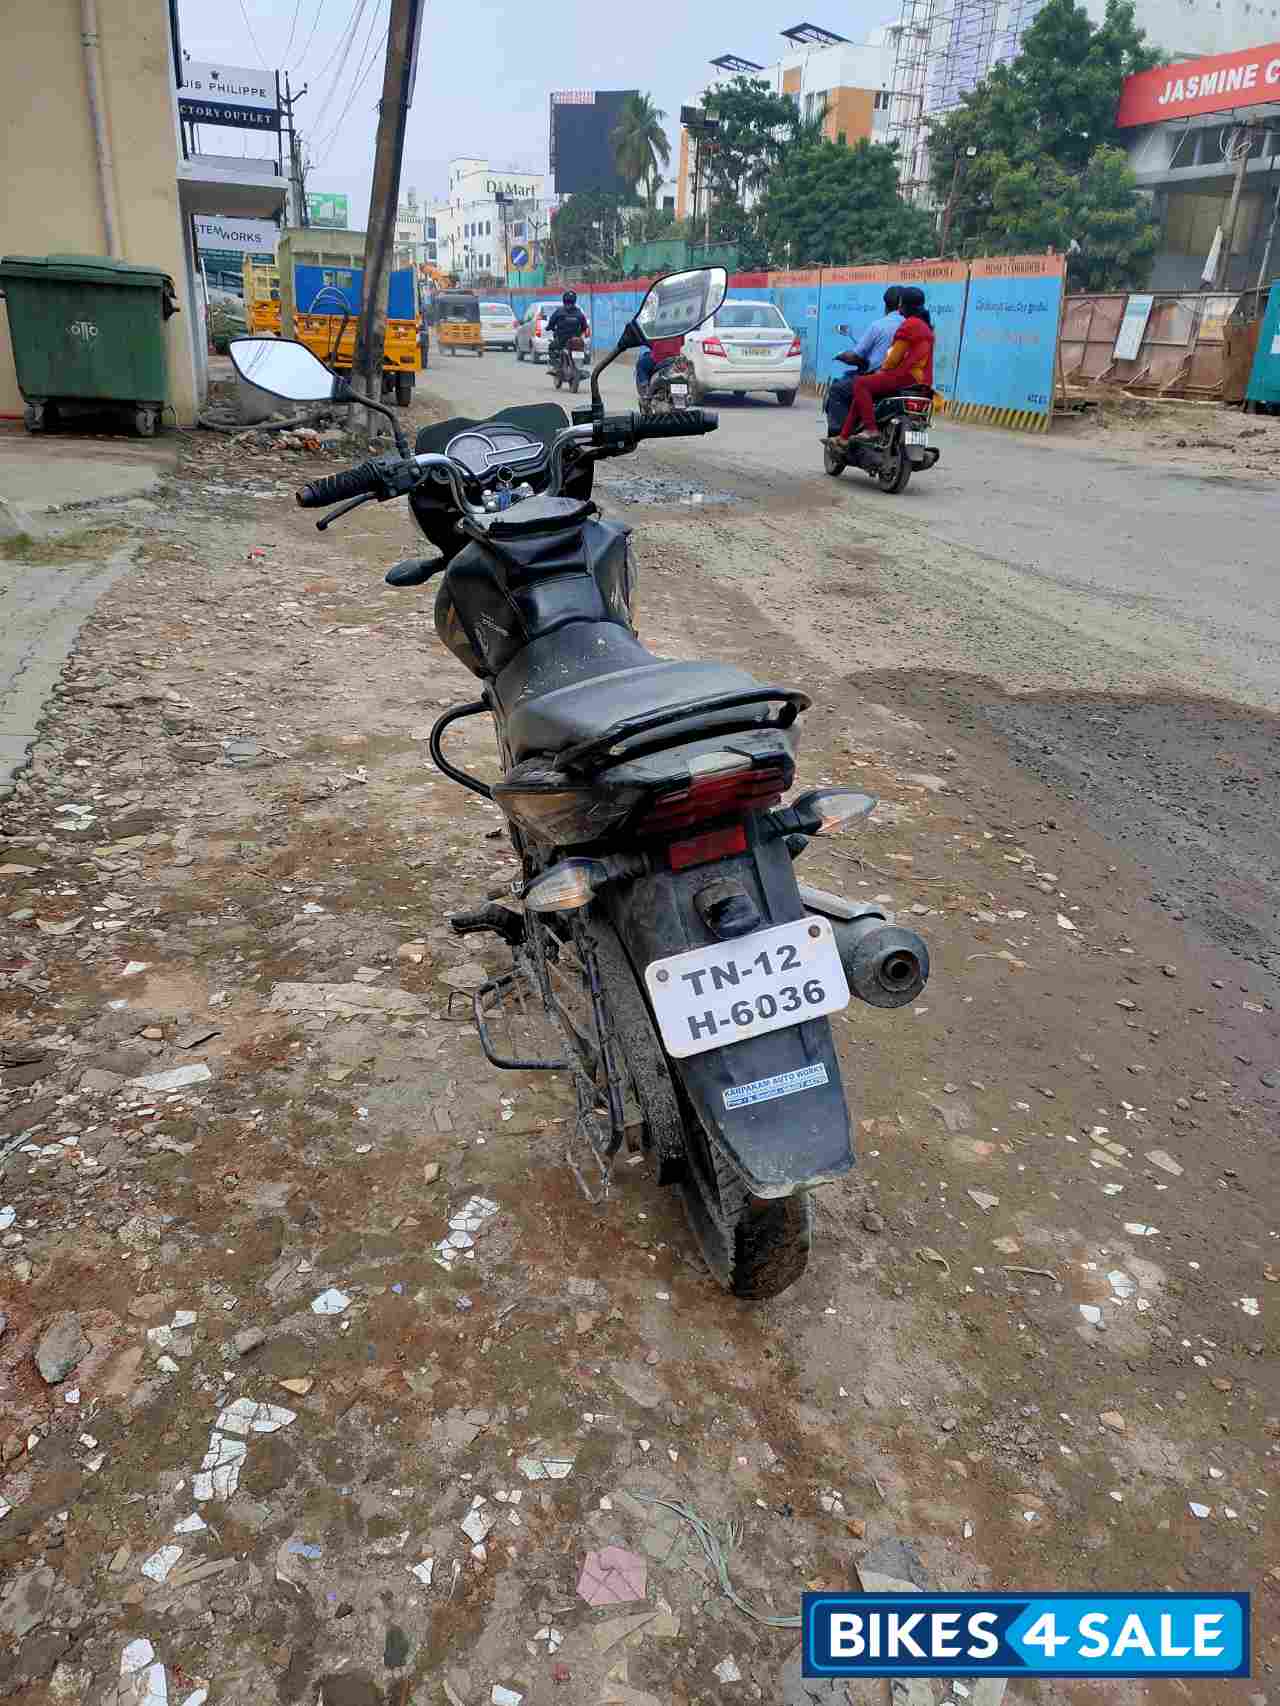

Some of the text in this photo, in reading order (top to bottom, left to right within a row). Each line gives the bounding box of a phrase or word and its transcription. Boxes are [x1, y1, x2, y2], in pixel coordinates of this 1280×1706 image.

[208, 81, 266, 98] PHILIPPE
[1158, 63, 1259, 105] JASMINE
[224, 110, 272, 124] OUTLET
[681, 944, 802, 996] TN-12
[687, 979, 826, 1041] H-6036
[770, 1073, 796, 1087] AUTO
[794, 1065, 825, 1081] WORKS
